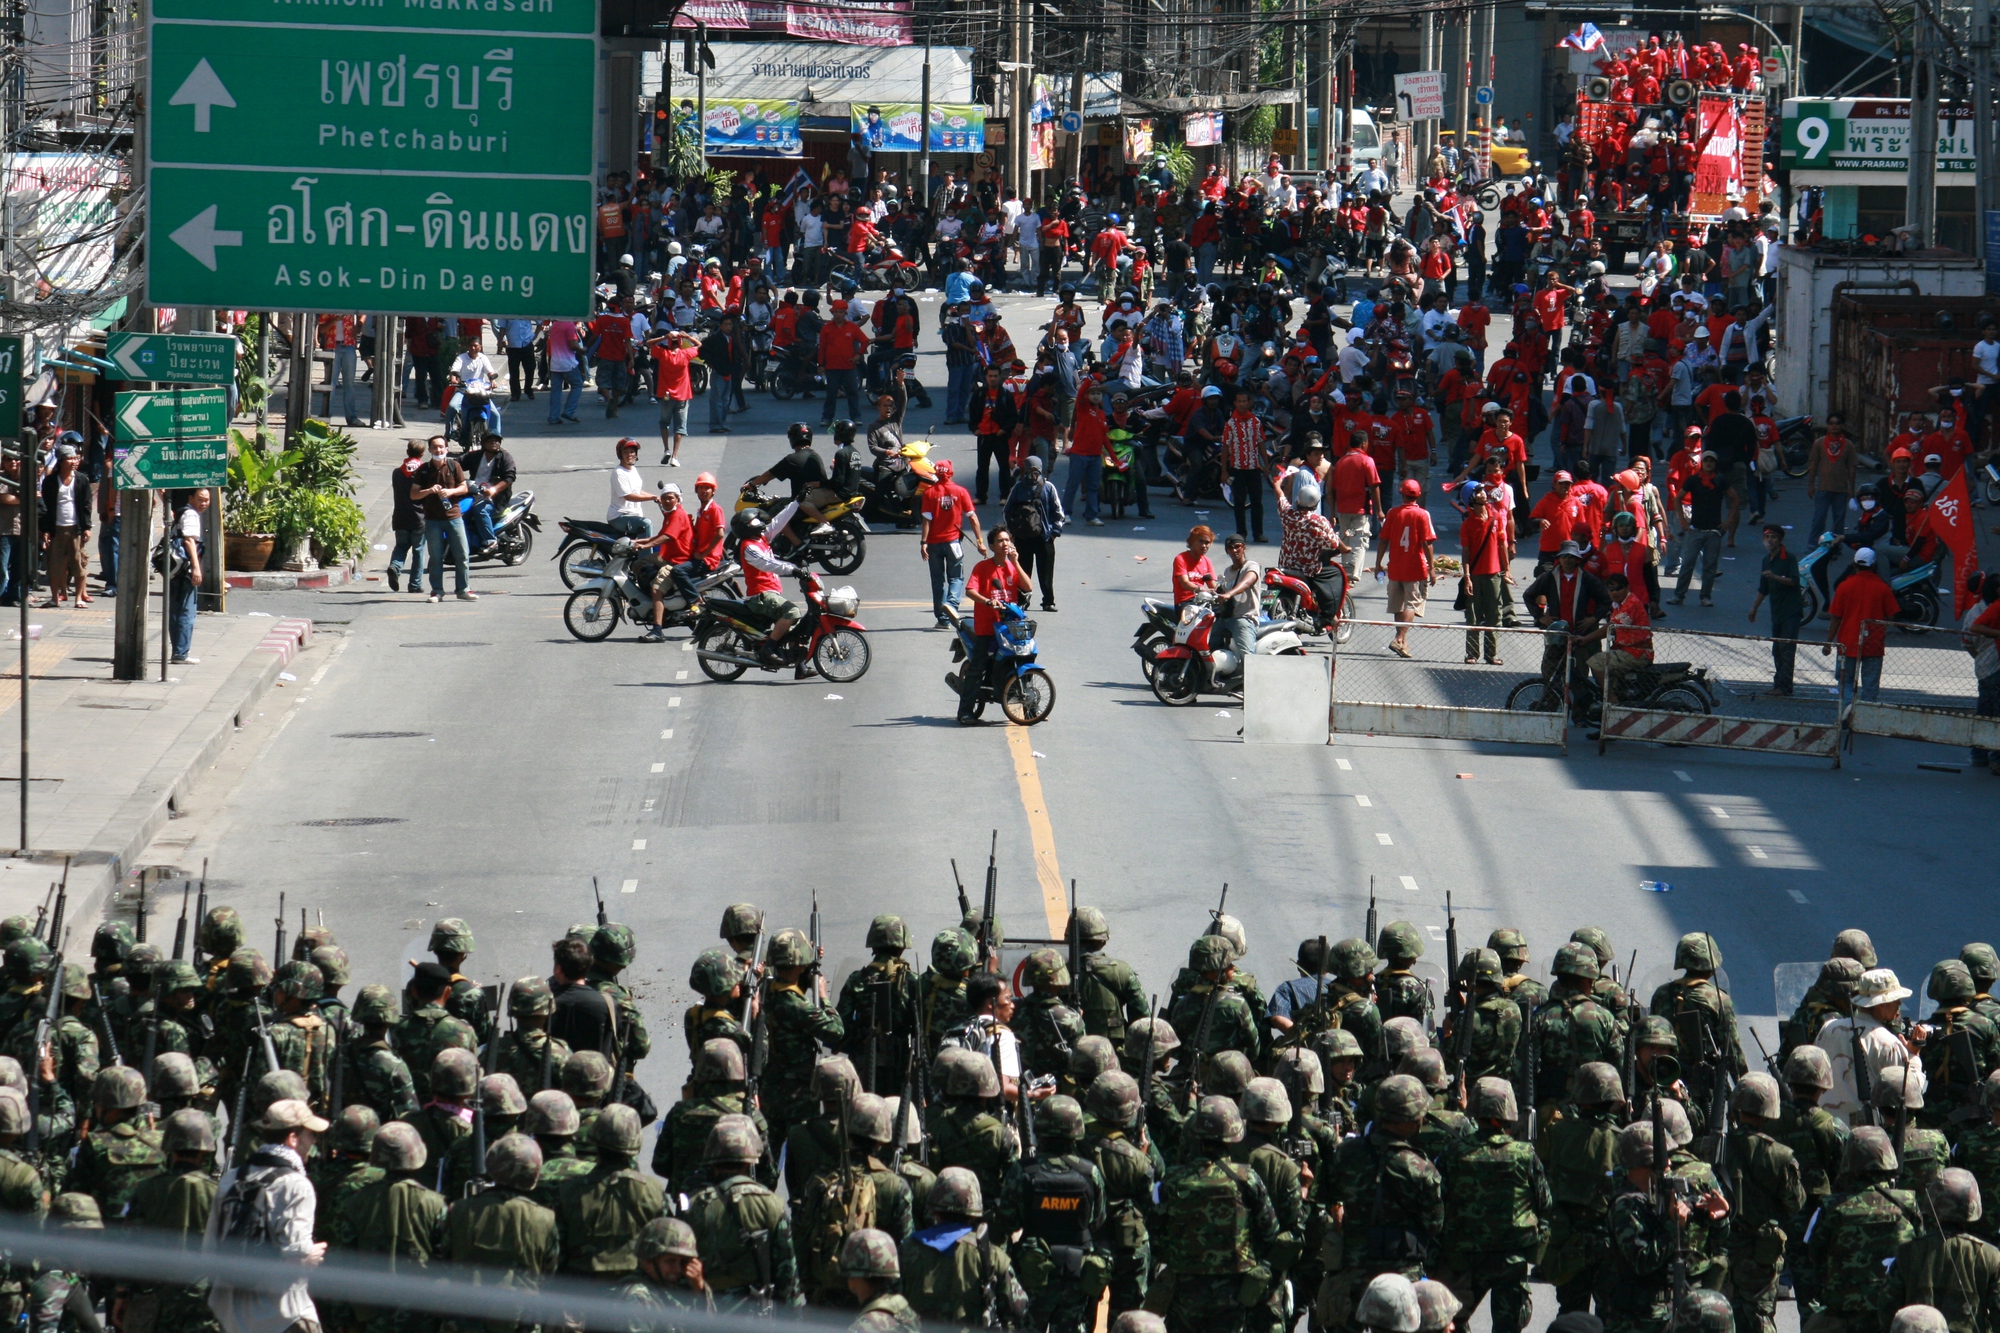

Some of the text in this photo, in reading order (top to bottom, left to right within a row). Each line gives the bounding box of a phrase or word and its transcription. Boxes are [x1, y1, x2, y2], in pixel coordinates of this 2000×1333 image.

[320, 47, 514, 127] เพชรบุรี
[1849, 121, 1910, 135] โรงพยาบา
[318, 123, 508, 153] Phetchaburi
[1796, 116, 1829, 160] 9
[1835, 160, 1908, 169] WWW.PRARAM9.
[268, 176, 587, 254] อโศก-ดินแดง
[440, 267, 535, 298] Daeng
[165, 337, 225, 353] โรงพยาบาล
[169, 353, 221, 370] ปิยะเวท
[166, 371, 224, 381] Piyavate Hospital
[160, 444, 216, 461] บึงมักกะสัน
[152, 472, 180, 480] Makkasan
[211, 471, 226, 479] Pond
[1400, 526, 1410, 553] 4
[1041, 1196, 1080, 1210] ARMY
